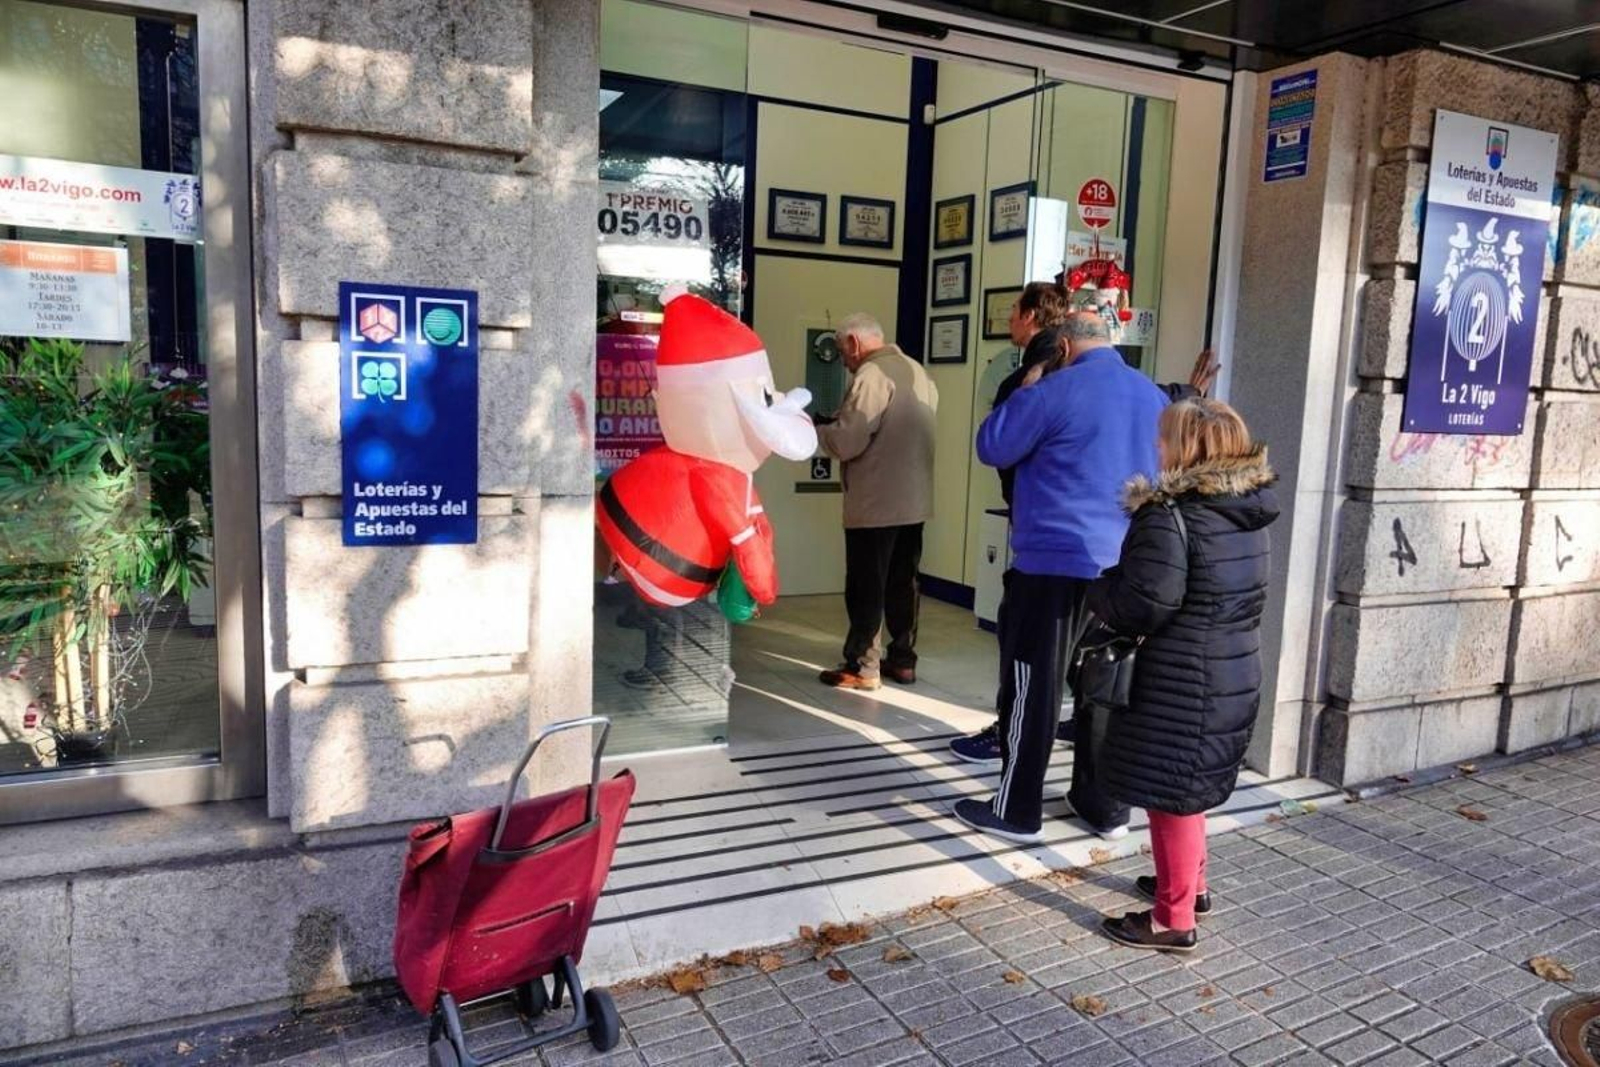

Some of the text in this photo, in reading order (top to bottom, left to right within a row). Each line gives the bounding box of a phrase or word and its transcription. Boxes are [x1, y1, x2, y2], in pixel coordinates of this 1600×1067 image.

[1447, 161, 1539, 194] Loterías y Apuestas
[620, 193, 693, 215] PREMIO
[1466, 186, 1516, 208] del Estado
[597, 208, 703, 241] 05490
[1467, 291, 1489, 344] 2
[1442, 383, 1496, 410] La 2 Vigo
[1448, 412, 1485, 426] LOTERÍAS
[353, 481, 443, 500] Loterías y
[354, 501, 468, 521] Apuestas del
[354, 521, 417, 537] Estado
